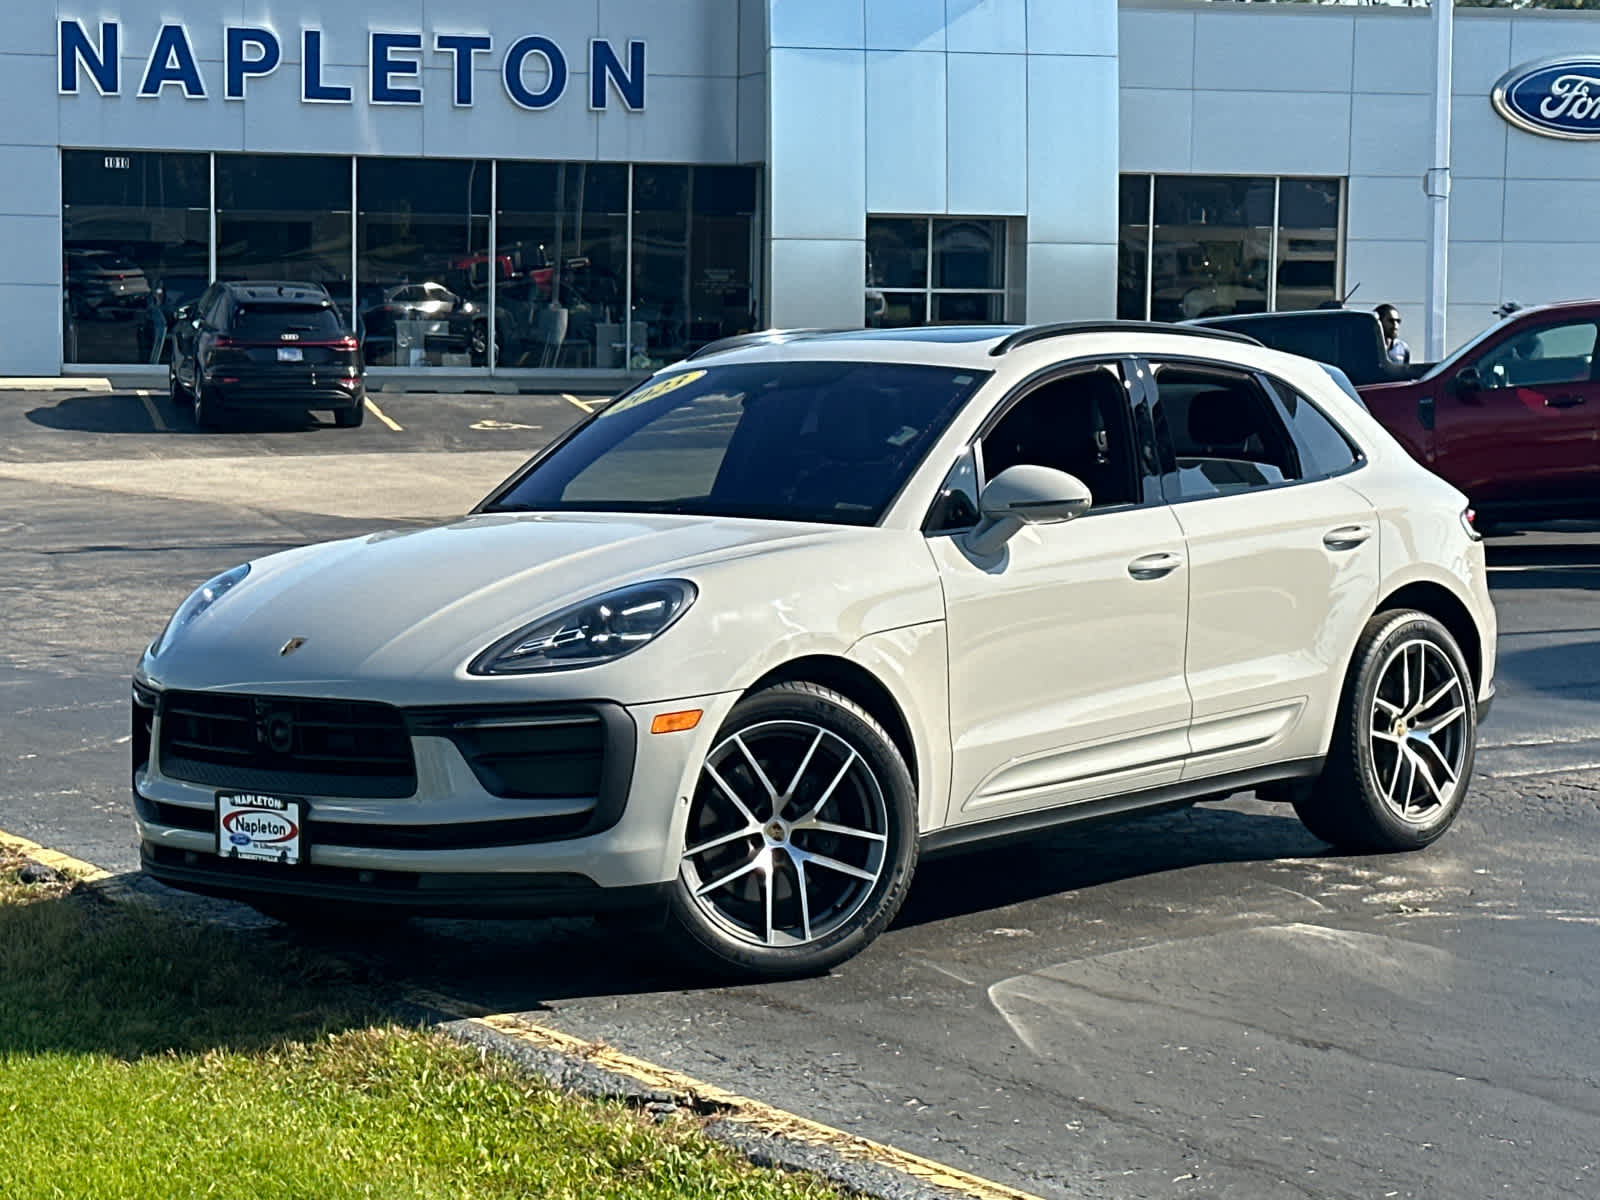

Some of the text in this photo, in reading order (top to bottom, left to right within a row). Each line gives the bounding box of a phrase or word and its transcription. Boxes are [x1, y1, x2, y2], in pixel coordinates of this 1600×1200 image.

[57, 18, 646, 111] NAPLETON
[104, 156, 130, 168] 1010
[233, 794, 284, 809] NAPLETON
[235, 816, 286, 836] Napleton
